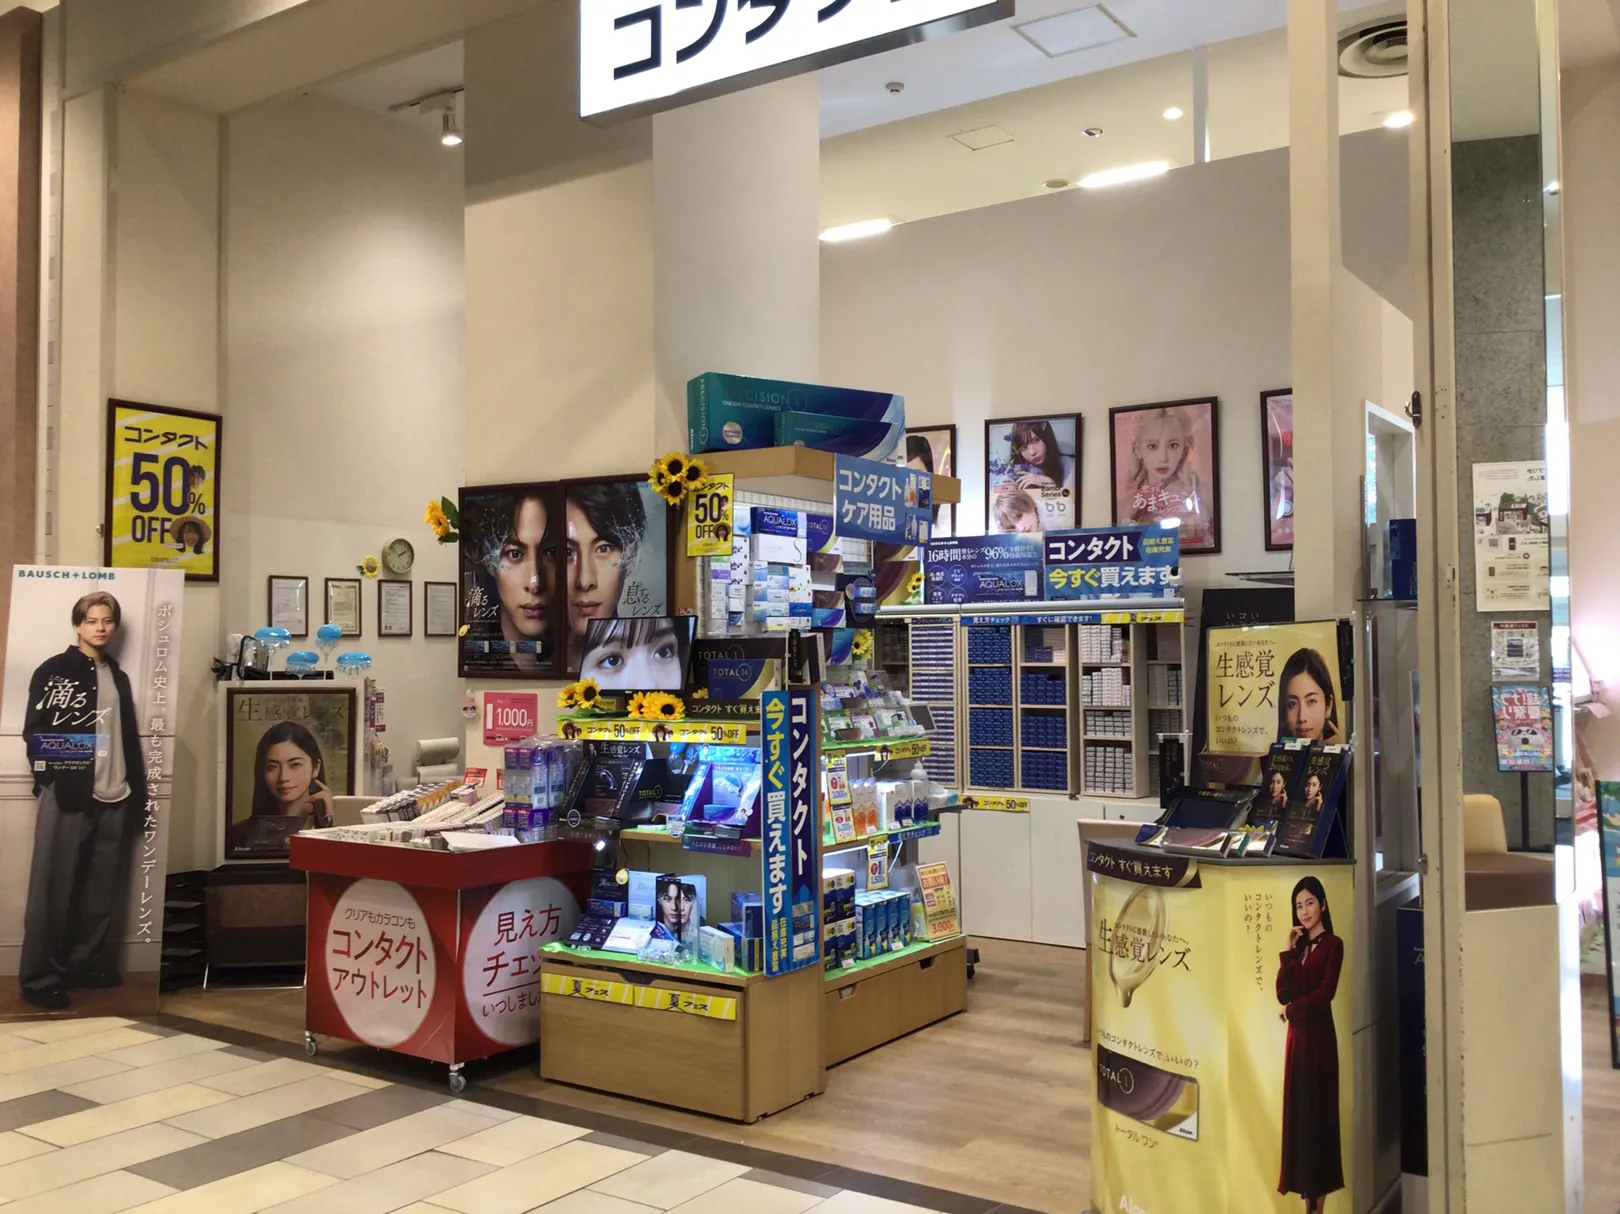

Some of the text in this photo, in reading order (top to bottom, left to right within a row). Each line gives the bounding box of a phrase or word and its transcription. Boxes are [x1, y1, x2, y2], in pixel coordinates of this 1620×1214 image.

[124, 426, 208, 450] コンタクト
[130, 451, 207, 516] 50%
[840, 469, 902, 501] コンタクト
[695, 492, 730, 523] 50%
[841, 499, 896, 531] ケア用品
[131, 515, 173, 544] OFF
[695, 524, 714, 539] OFF
[763, 515, 797, 527] AQUALOX
[927, 548, 962, 563] 16時間
[984, 546, 1010, 560] 96%
[1049, 536, 1134, 560] コンタクト
[979, 580, 1023, 589] AQUALOX
[1049, 565, 1177, 589] 今すぐ買えます
[464, 587, 489, 608] 滴る
[632, 602, 663, 616] レンズ
[473, 604, 499, 618] レンズ
[697, 650, 728, 660] TOTAL
[1216, 649, 1275, 679] 生感覚
[713, 668, 740, 677] TOTAL
[35, 679, 88, 710] 滴る
[1218, 680, 1276, 709] レンズ
[52, 707, 112, 727] レンズ
[236, 697, 346, 721] 生感覚レンズ
[692, 704, 722, 714] コンタクト
[41, 741, 93, 750] AQUALOX
[792, 697, 810, 875] コンタクト
[765, 698, 787, 915] 今すぐ買えます
[1118, 859, 1173, 879] すぐ買えます
[345, 908, 416, 929] クリアもカラコンも
[494, 903, 562, 946] 見え方
[1265, 893, 1273, 933] いつもの
[333, 929, 428, 975] コンタクト
[1099, 918, 1192, 972] 生感覚レンズ
[1255, 893, 1264, 991] コンタクトレンズで、
[333, 967, 427, 1009] アウトレット
[1100, 1063, 1122, 1084] TOTAL
